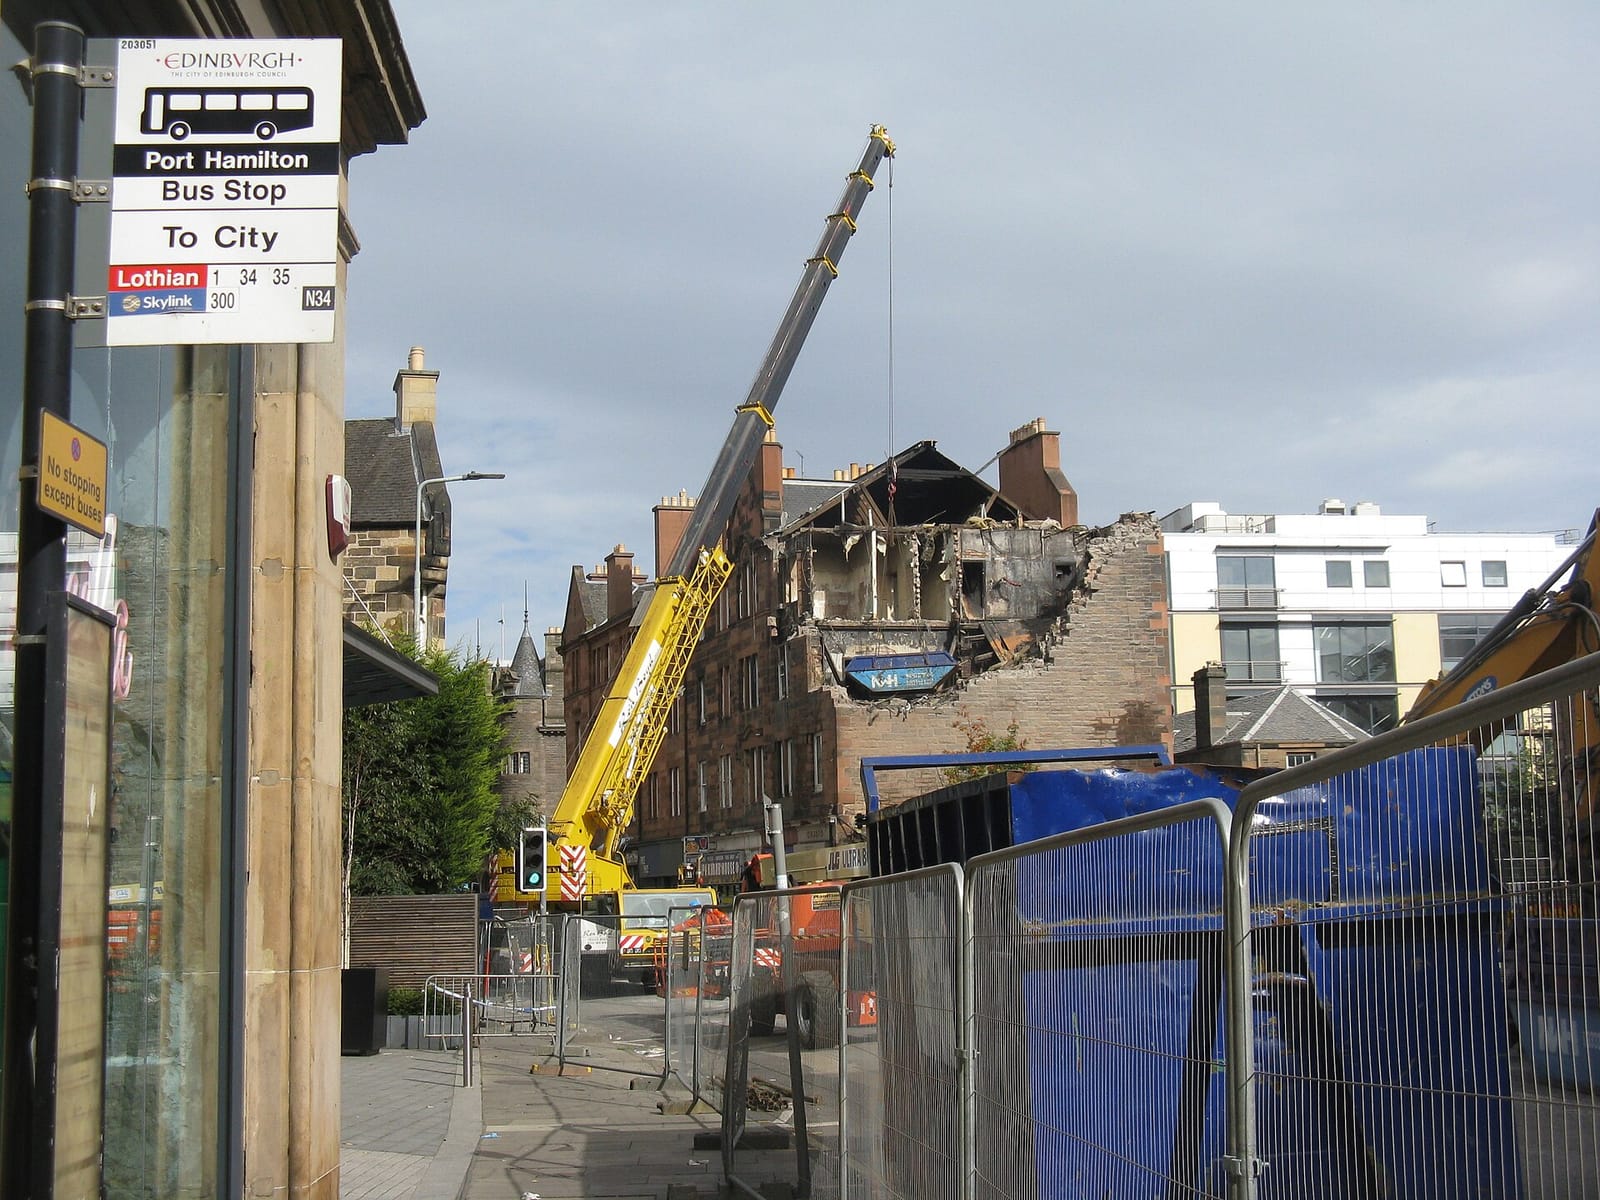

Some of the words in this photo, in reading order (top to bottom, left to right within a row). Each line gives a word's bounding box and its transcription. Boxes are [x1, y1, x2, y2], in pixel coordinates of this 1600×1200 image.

[121, 40, 156, 49] 203051
[145, 151, 194, 171] Port
[204, 150, 309, 170] Hamilton
[162, 180, 214, 201] Bus
[223, 180, 287, 205] Stop
[163, 226, 198, 249] To
[214, 226, 278, 252] City
[117, 270, 199, 288] Lothian
[213, 270, 219, 286] 1
[239, 269, 257, 285] 34
[272, 268, 290, 285] 35
[143, 294, 193, 312] Skylink
[210, 292, 235, 309] 300
[305, 289, 332, 307] N34
[47, 455, 61, 478] No
[63, 466, 101, 502] stopping
[44, 483, 75, 510] except
[77, 496, 102, 523] buses
